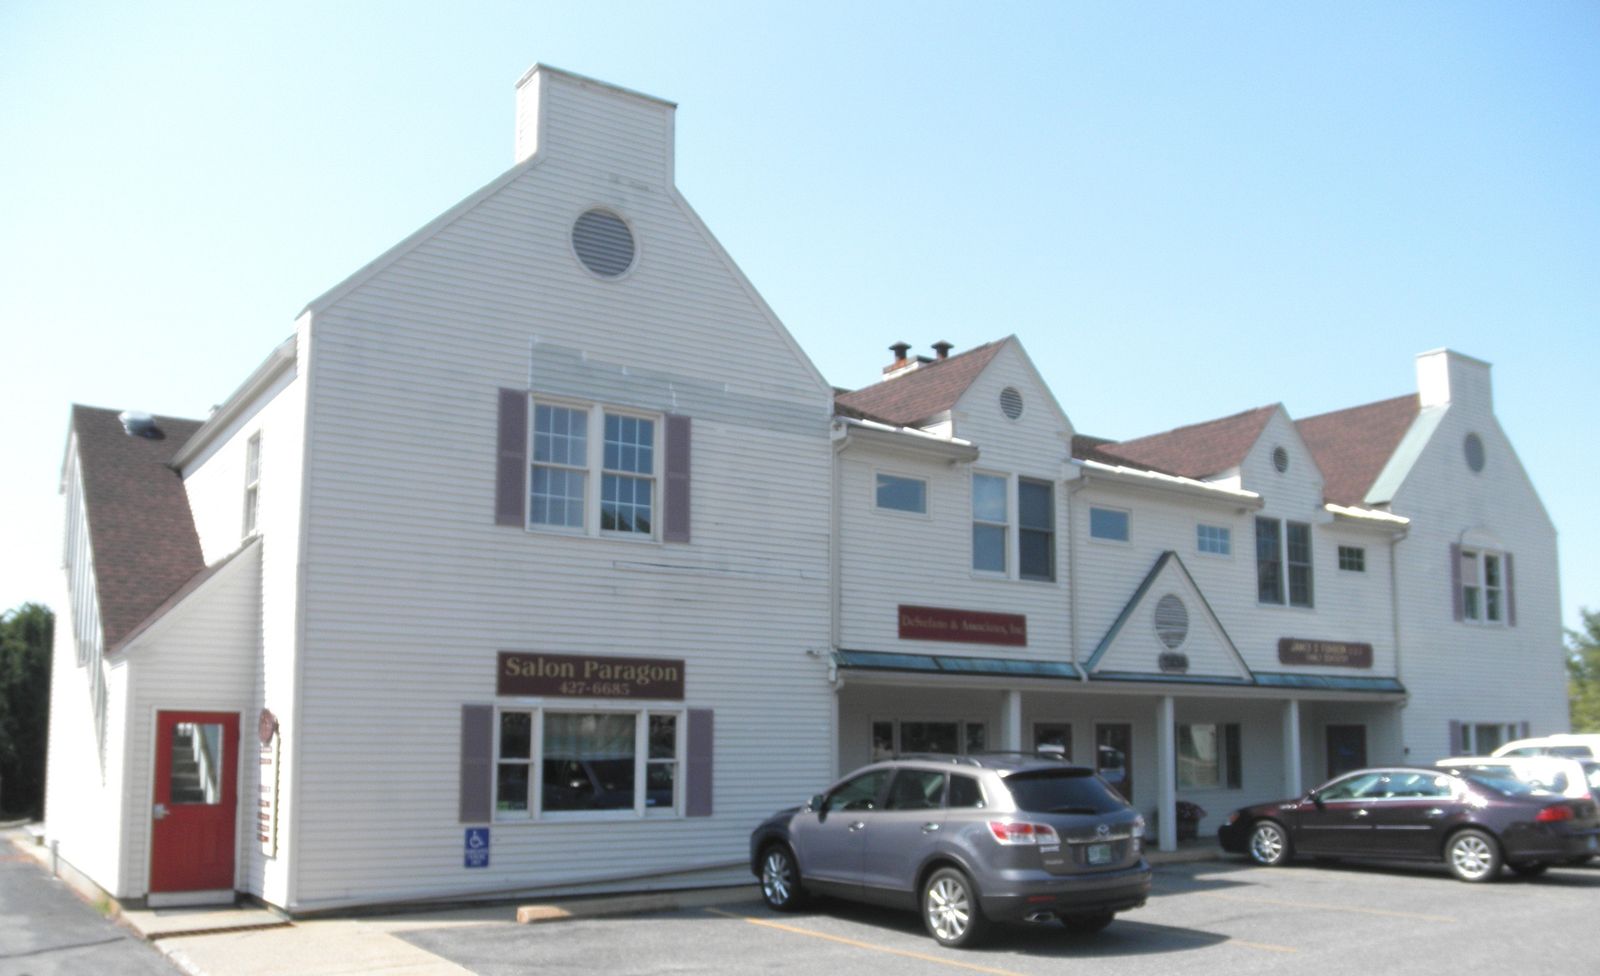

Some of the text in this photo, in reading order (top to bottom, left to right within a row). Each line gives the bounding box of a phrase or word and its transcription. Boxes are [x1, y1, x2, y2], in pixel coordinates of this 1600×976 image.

[505, 656, 678, 685] Salon Paragon
[559, 680, 630, 696] 427-6685
